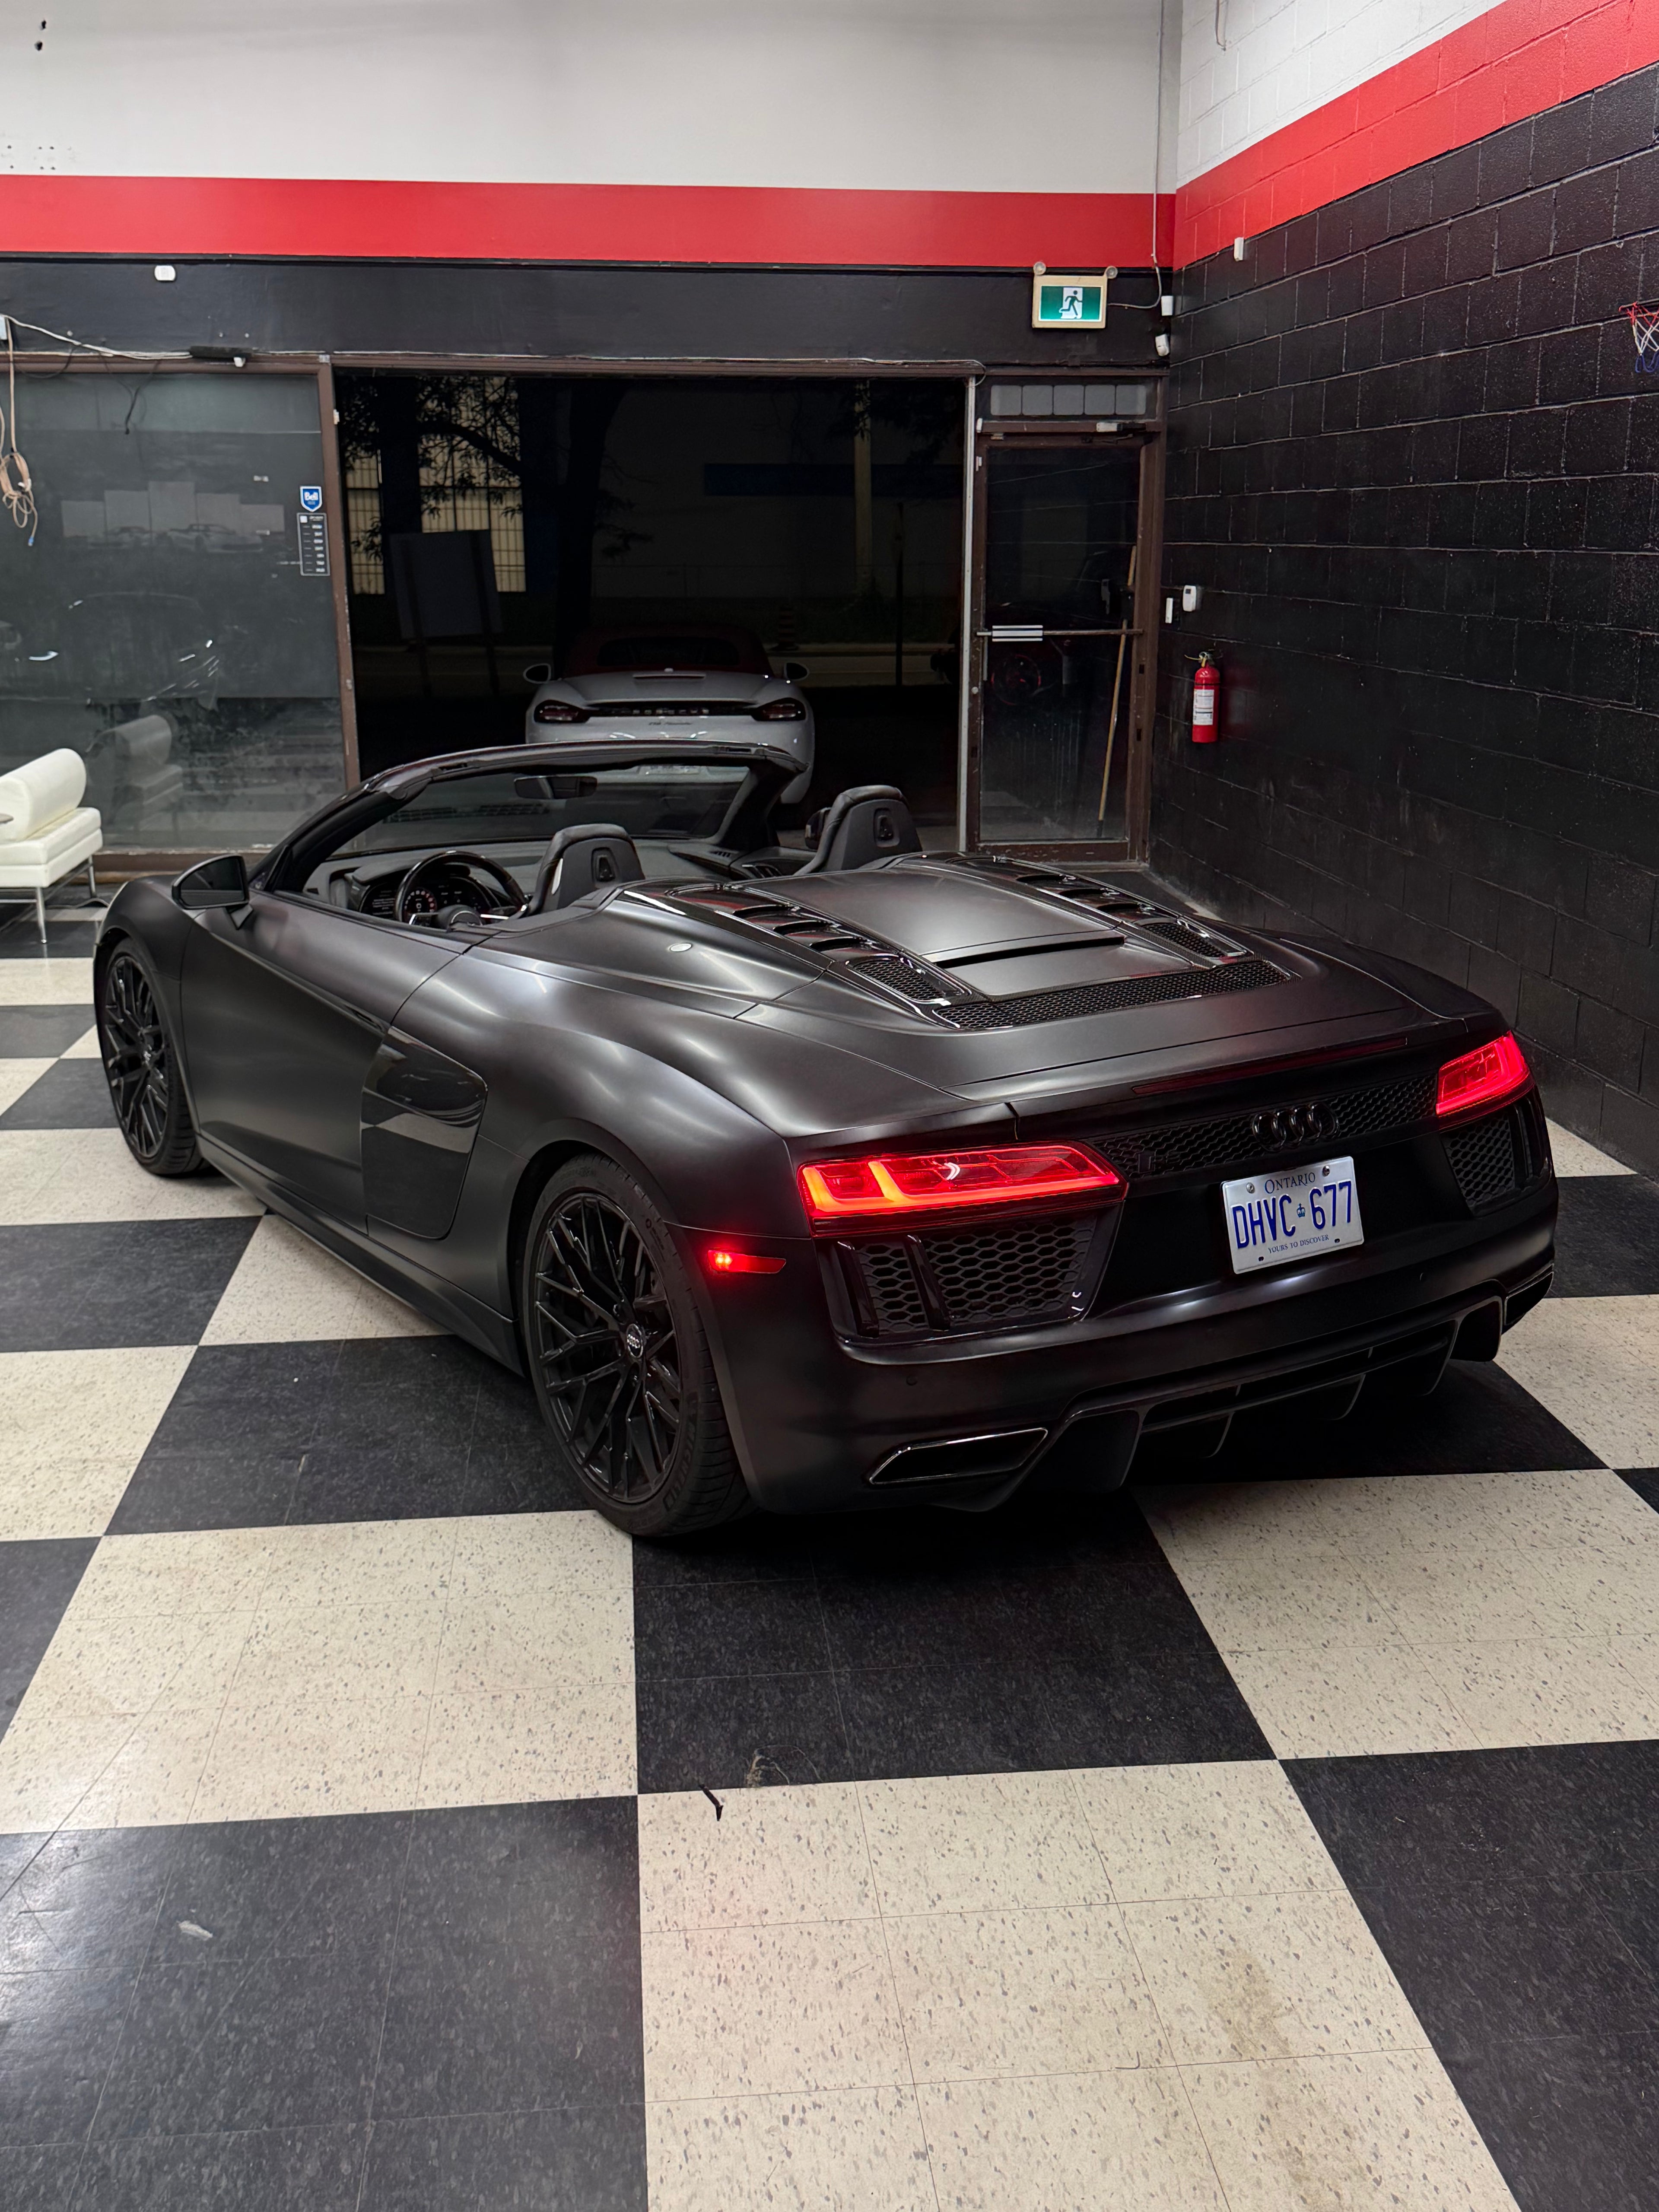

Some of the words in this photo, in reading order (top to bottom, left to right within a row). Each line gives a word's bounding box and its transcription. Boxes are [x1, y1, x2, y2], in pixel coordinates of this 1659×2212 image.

[1265, 1172, 1316, 1194] ONTARIO
[1233, 1195, 1296, 1249] DHVC
[1309, 1181, 1352, 1230] 677
[1268, 1243, 1288, 1254] YOURS
[1300, 1234, 1329, 1247] DISCOVER
